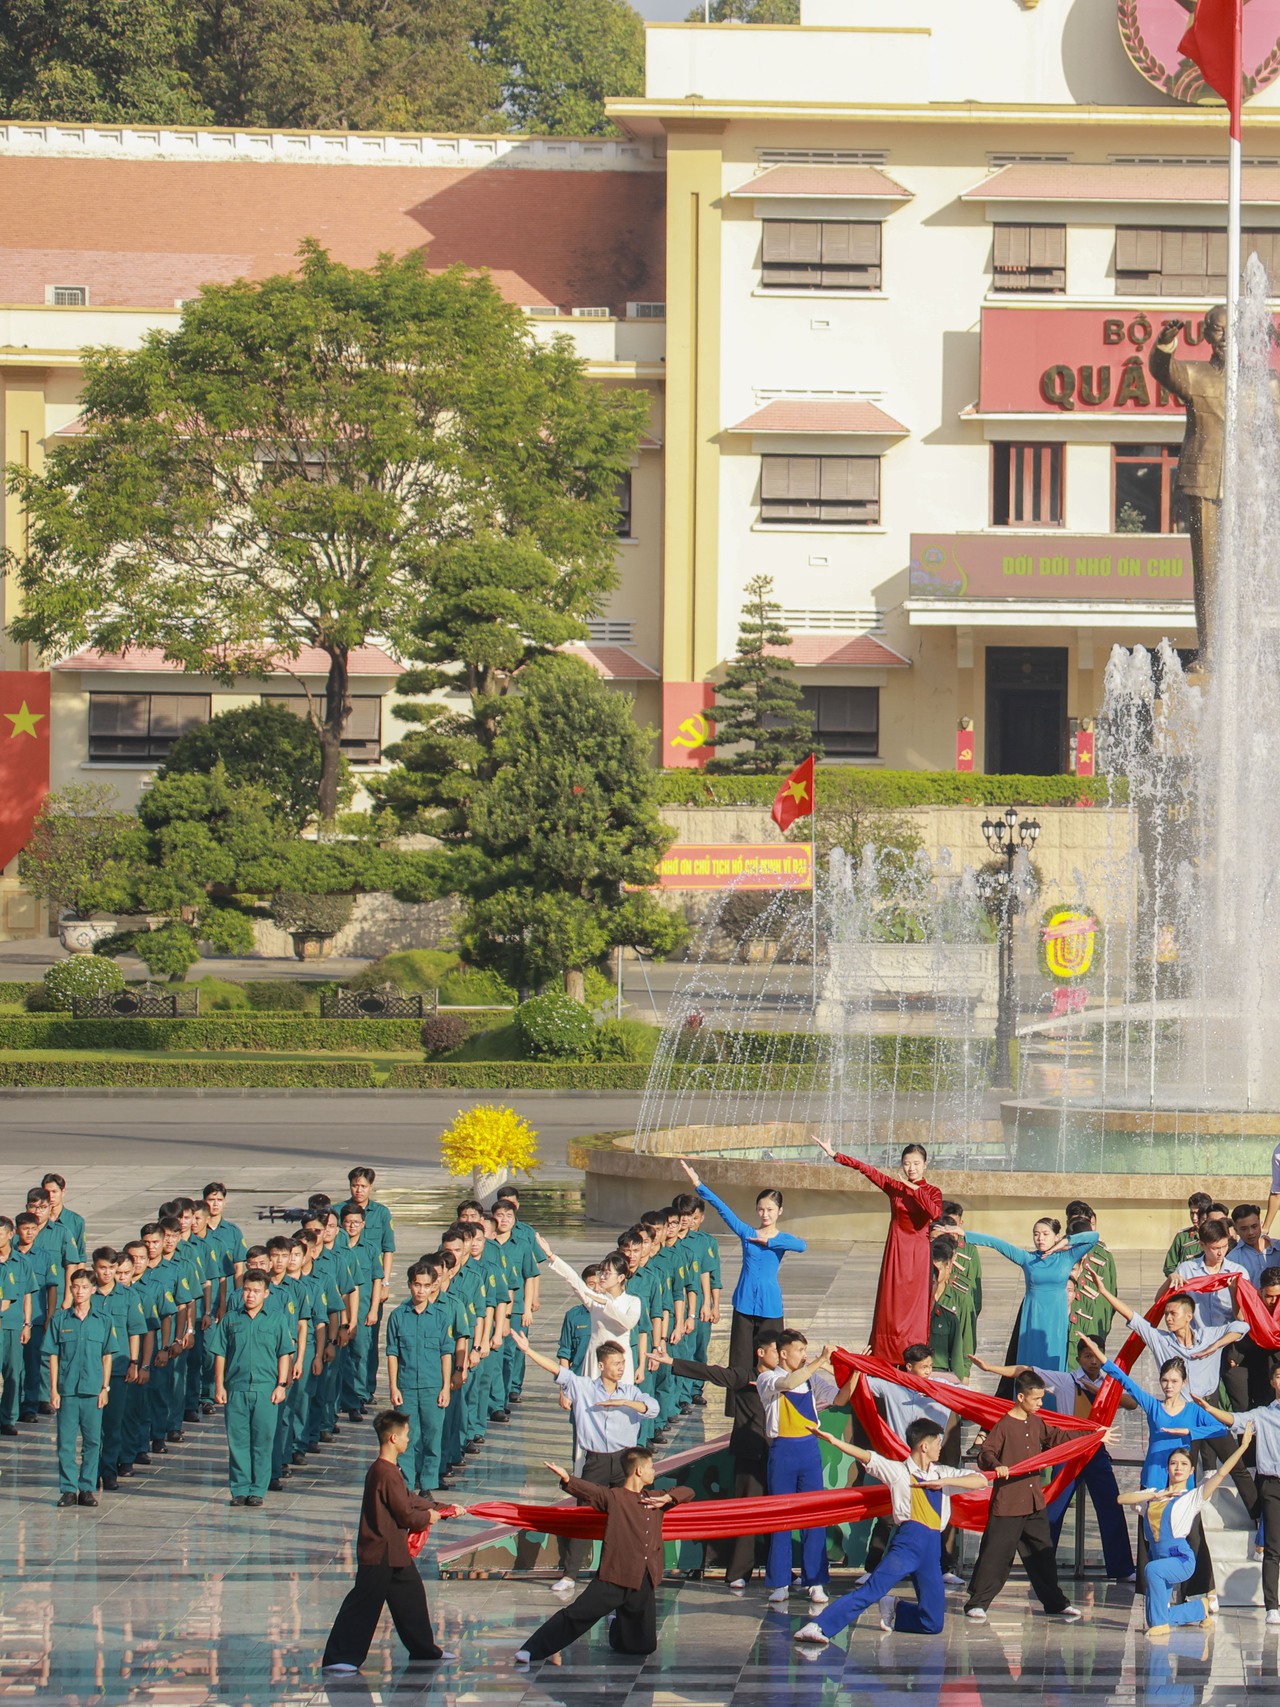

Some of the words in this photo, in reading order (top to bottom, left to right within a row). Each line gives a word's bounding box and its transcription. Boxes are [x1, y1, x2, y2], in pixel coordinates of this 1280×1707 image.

[1104, 313, 1152, 351] BỘ
[1075, 555, 1112, 576] NHỚ
[1117, 556, 1141, 576] ƠN
